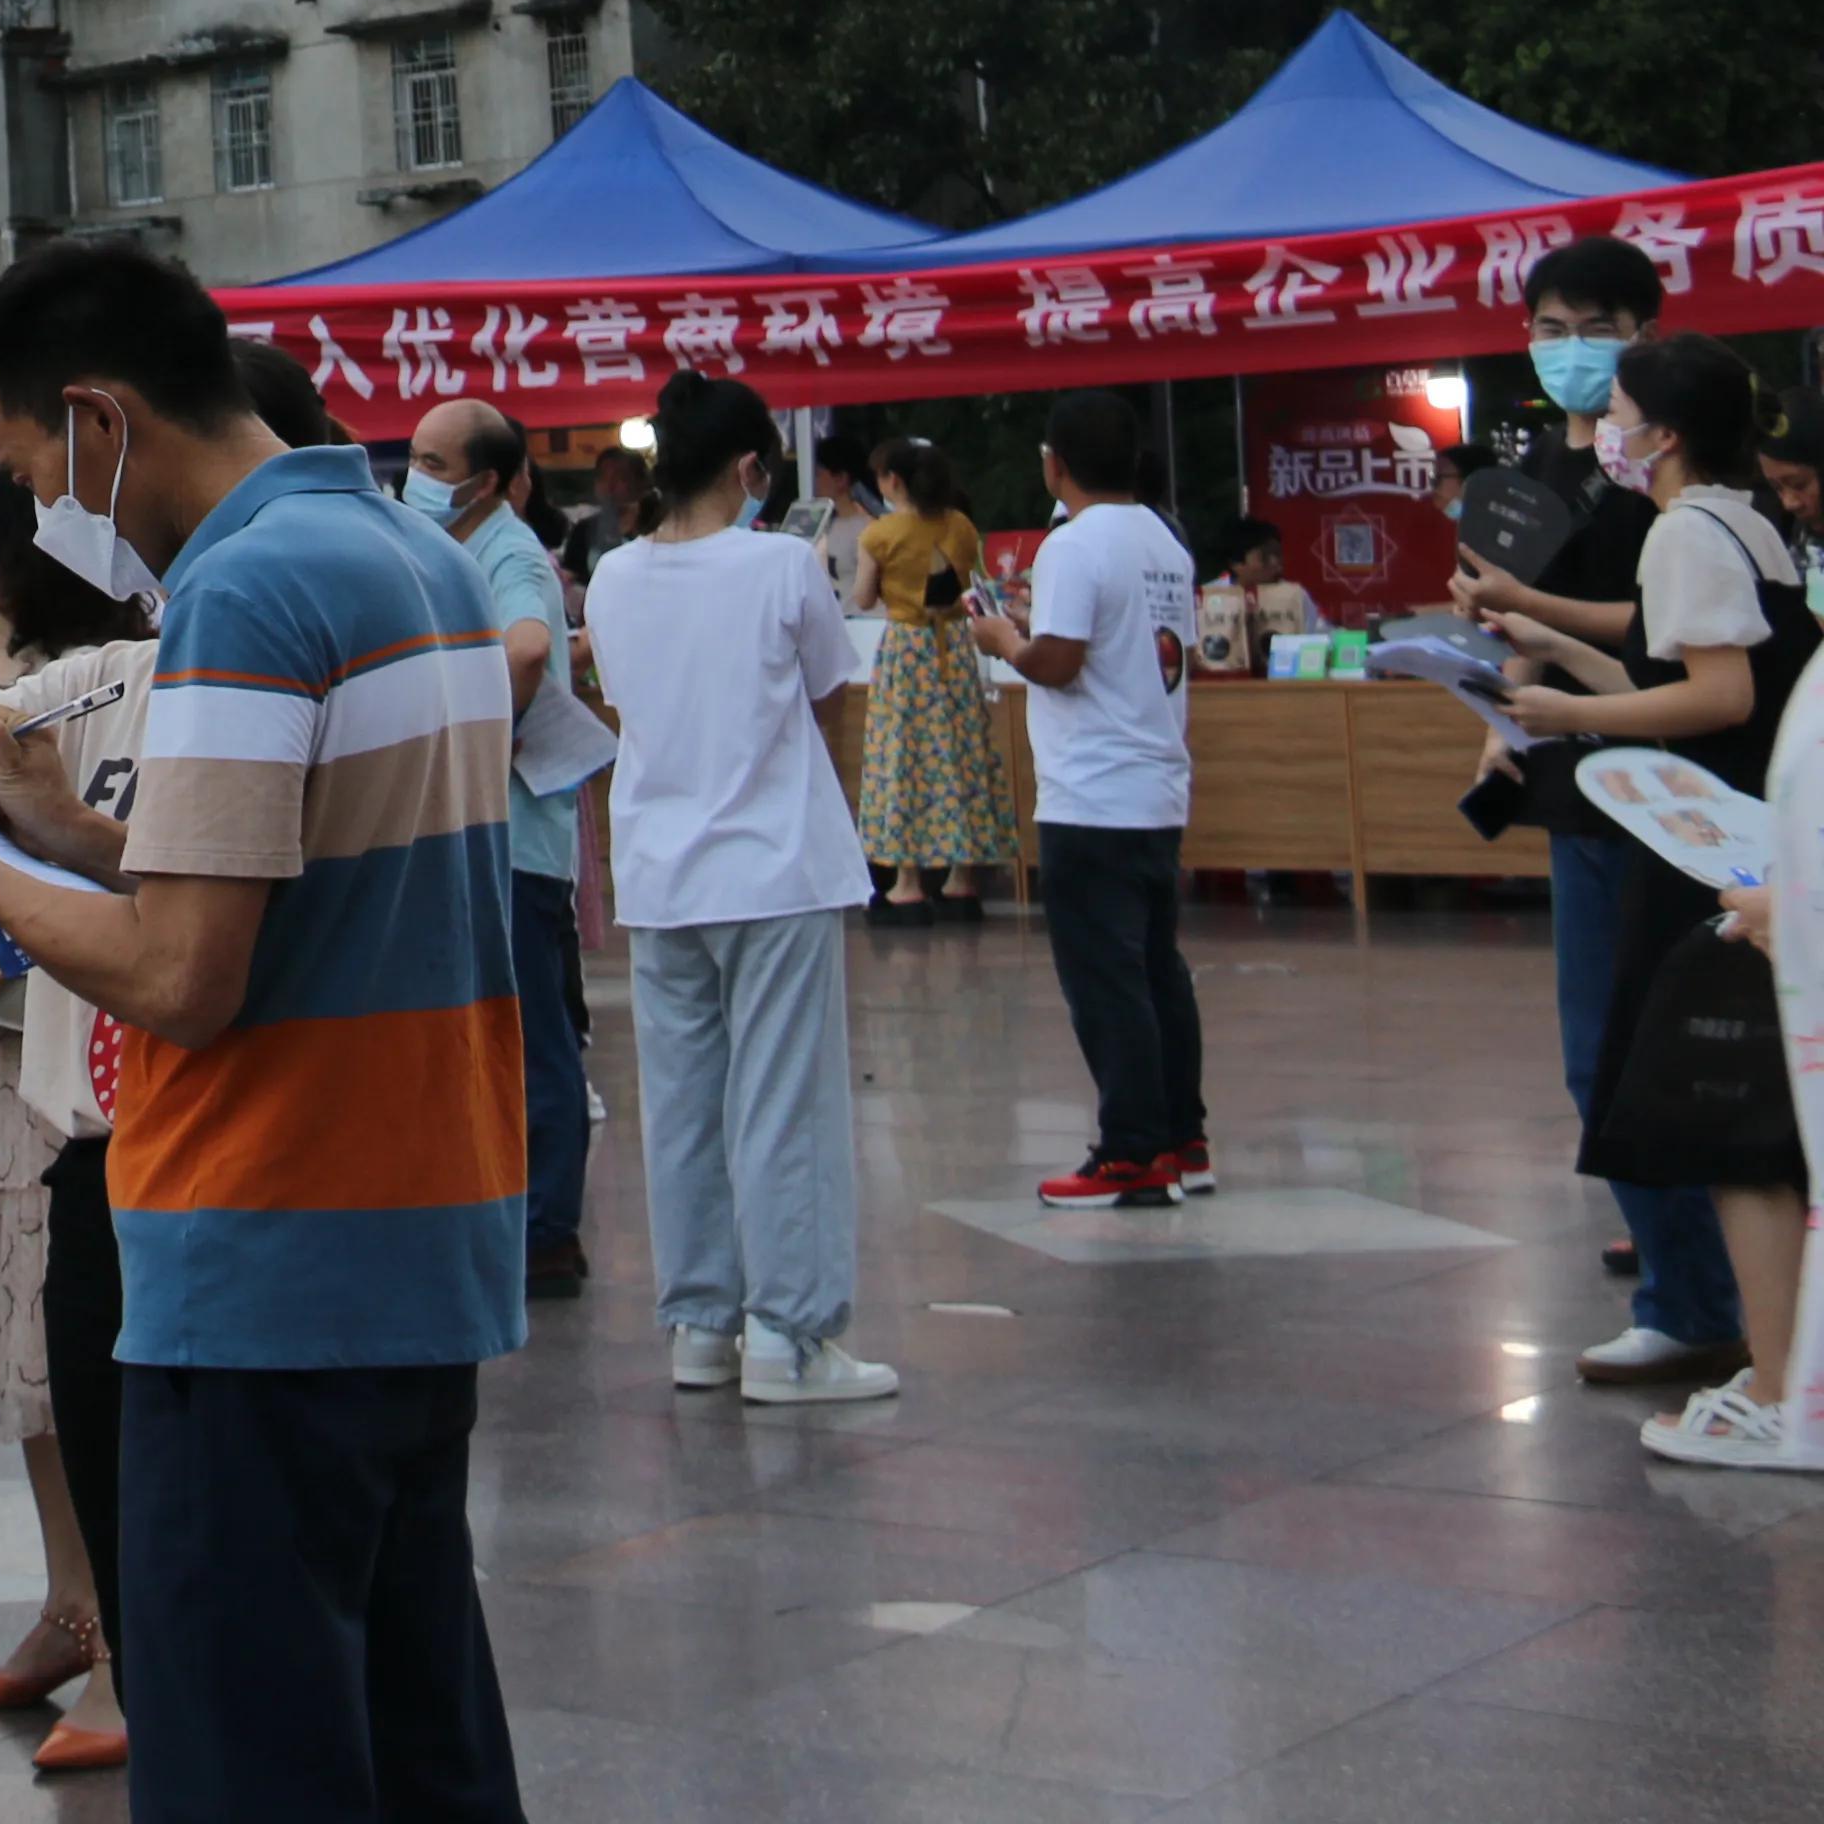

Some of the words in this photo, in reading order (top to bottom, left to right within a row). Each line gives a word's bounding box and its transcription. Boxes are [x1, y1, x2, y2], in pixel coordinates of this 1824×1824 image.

[227, 277, 953, 402] 入优化营商环境
[1268, 428, 1437, 499] 新品上市
